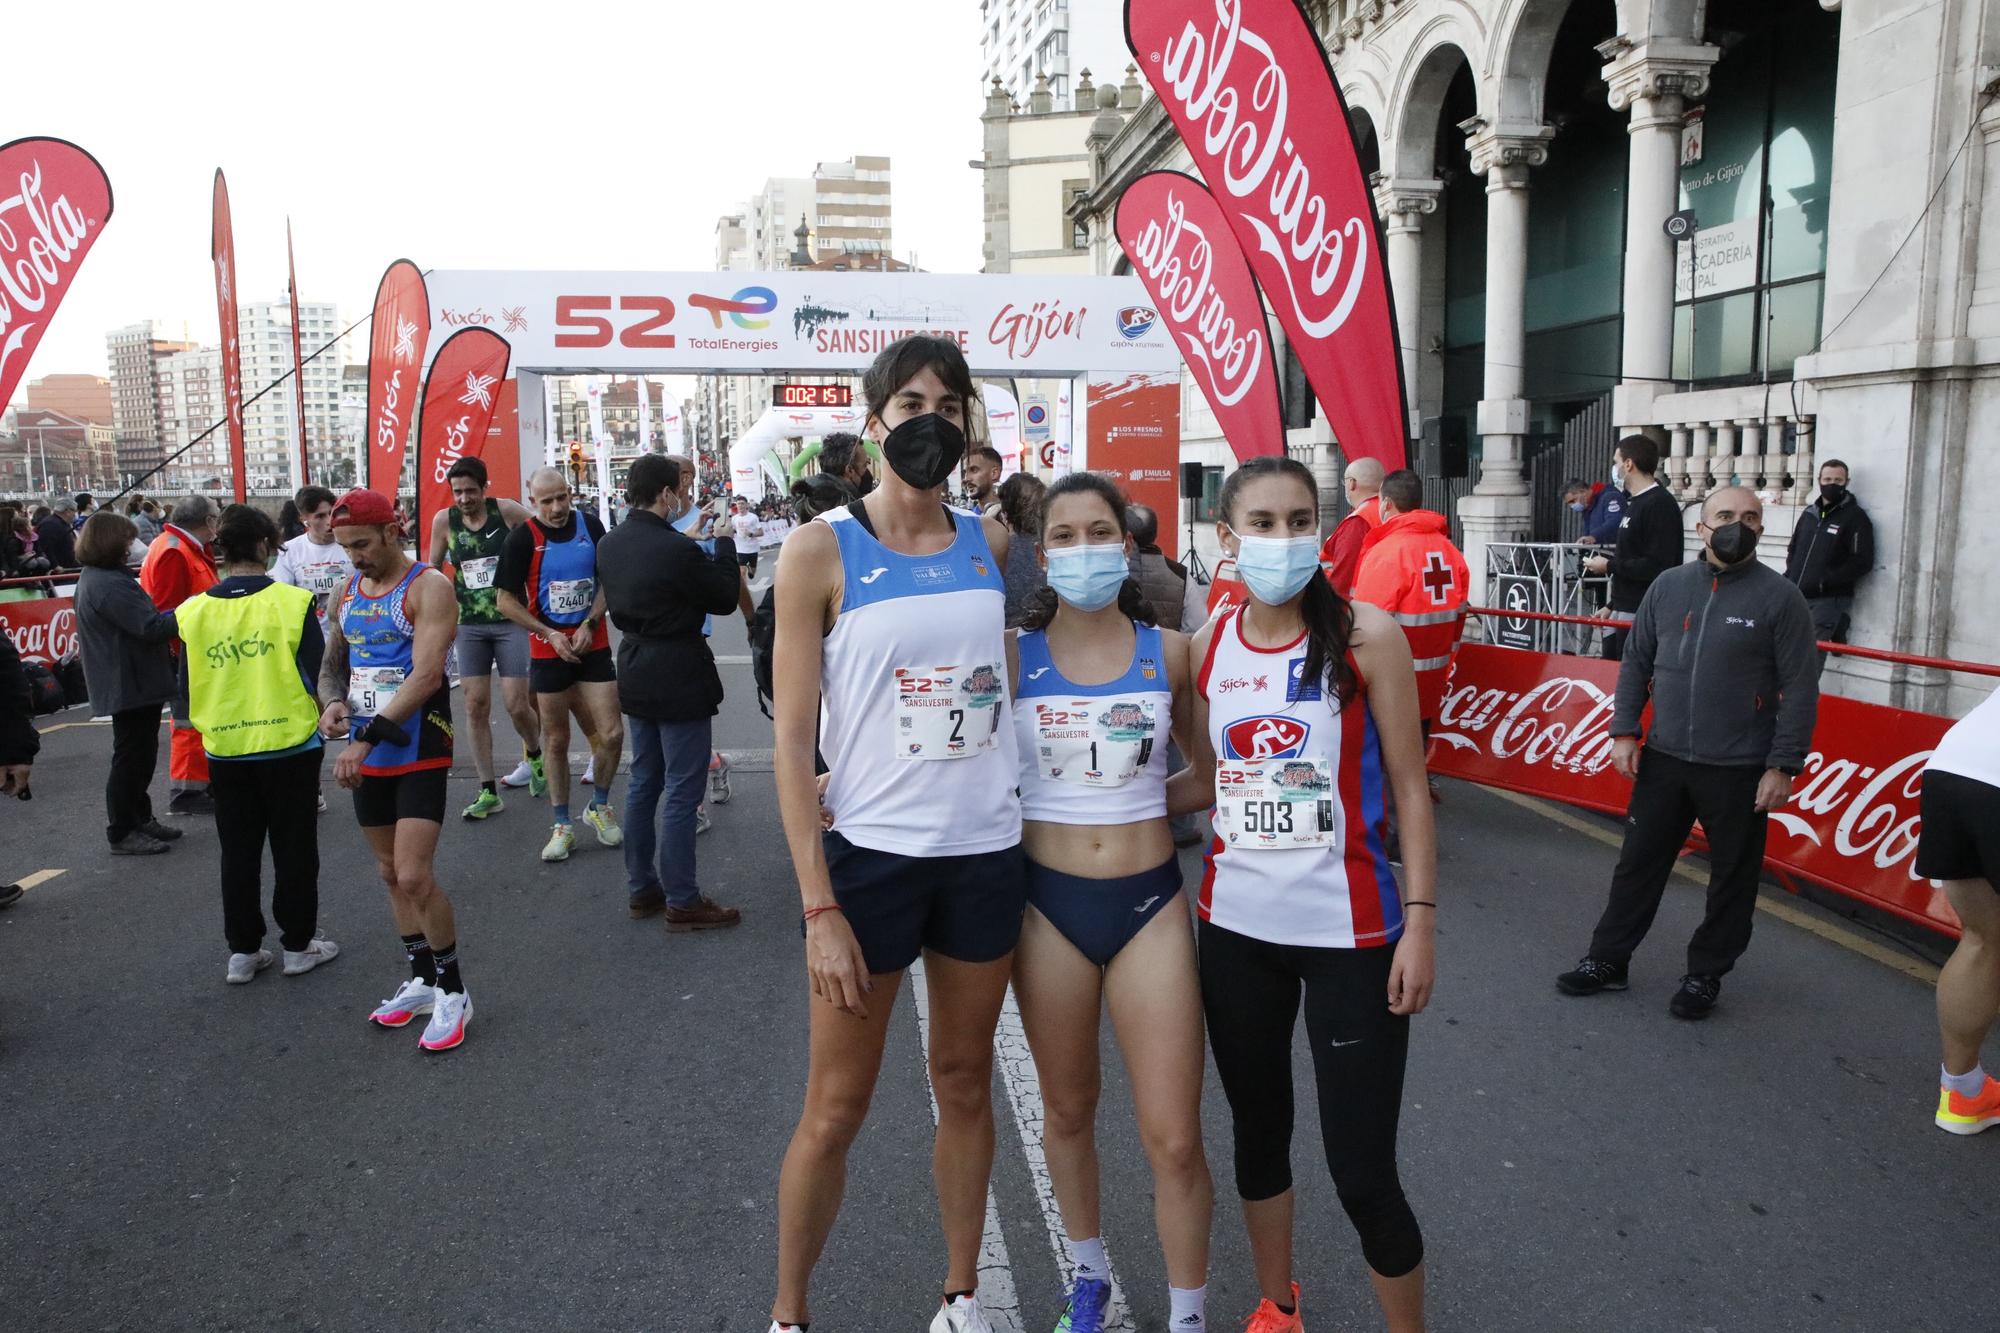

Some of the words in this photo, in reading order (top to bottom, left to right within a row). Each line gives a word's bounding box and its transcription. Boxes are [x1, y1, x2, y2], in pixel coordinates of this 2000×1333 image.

[1702, 172, 1715, 187] de
[1717, 163, 1745, 183] Gijón
[1136, 189, 1262, 406] Coca-Cola
[554, 295, 676, 349] 52
[988, 299, 1088, 361] Gijón
[687, 337, 778, 353] TotalEnergies
[378, 370, 401, 453] gijón
[1144, 469, 1171, 477] EMULSA
[314, 577, 334, 589] 1410
[476, 571, 489, 583] 80
[558, 594, 584, 608] 2440
[206, 630, 275, 669] gijón
[900, 678, 932, 693] 52
[1218, 677, 1250, 694] gijón
[364, 690, 376, 708] 51
[904, 697, 953, 708] SANSILVESTRE
[949, 709, 964, 742] 2
[1039, 711, 1069, 726] 52
[1043, 730, 1089, 739] SANSILVESTRE
[1089, 741, 1097, 771] 1
[1219, 770, 1245, 784] 52
[1224, 789, 1264, 798] SANSILVESTRE
[1244, 801, 1293, 833] 503
